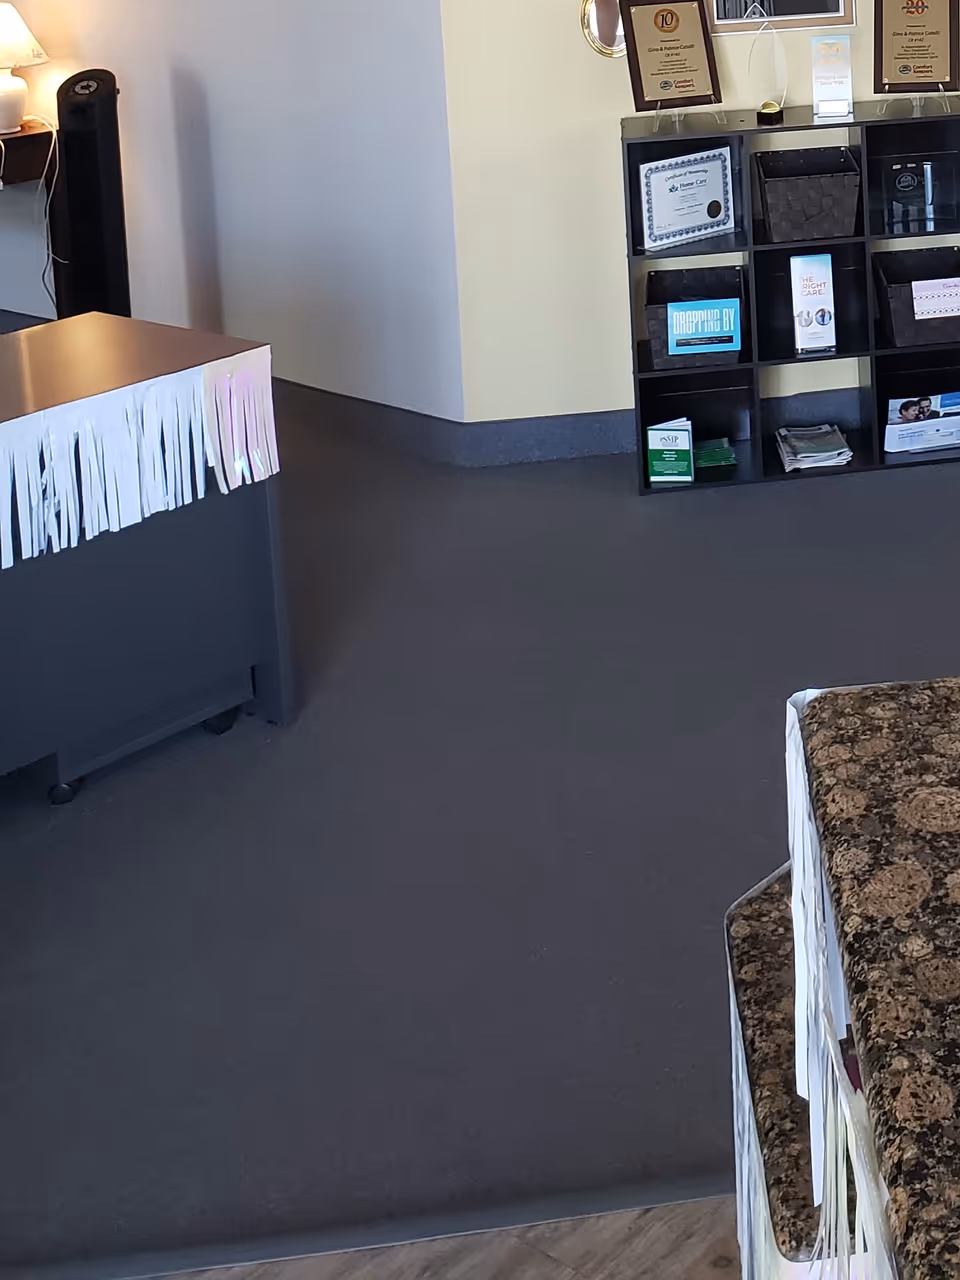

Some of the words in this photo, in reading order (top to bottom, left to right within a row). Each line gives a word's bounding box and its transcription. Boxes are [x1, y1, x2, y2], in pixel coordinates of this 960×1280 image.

[905, 0, 925, 15] 20
[660, 11, 674, 28] 10
[680, 181, 694, 189] Home
[802, 281, 827, 291] RIGHT
[673, 310, 721, 335] DROPPING
[723, 308, 735, 331] BY
